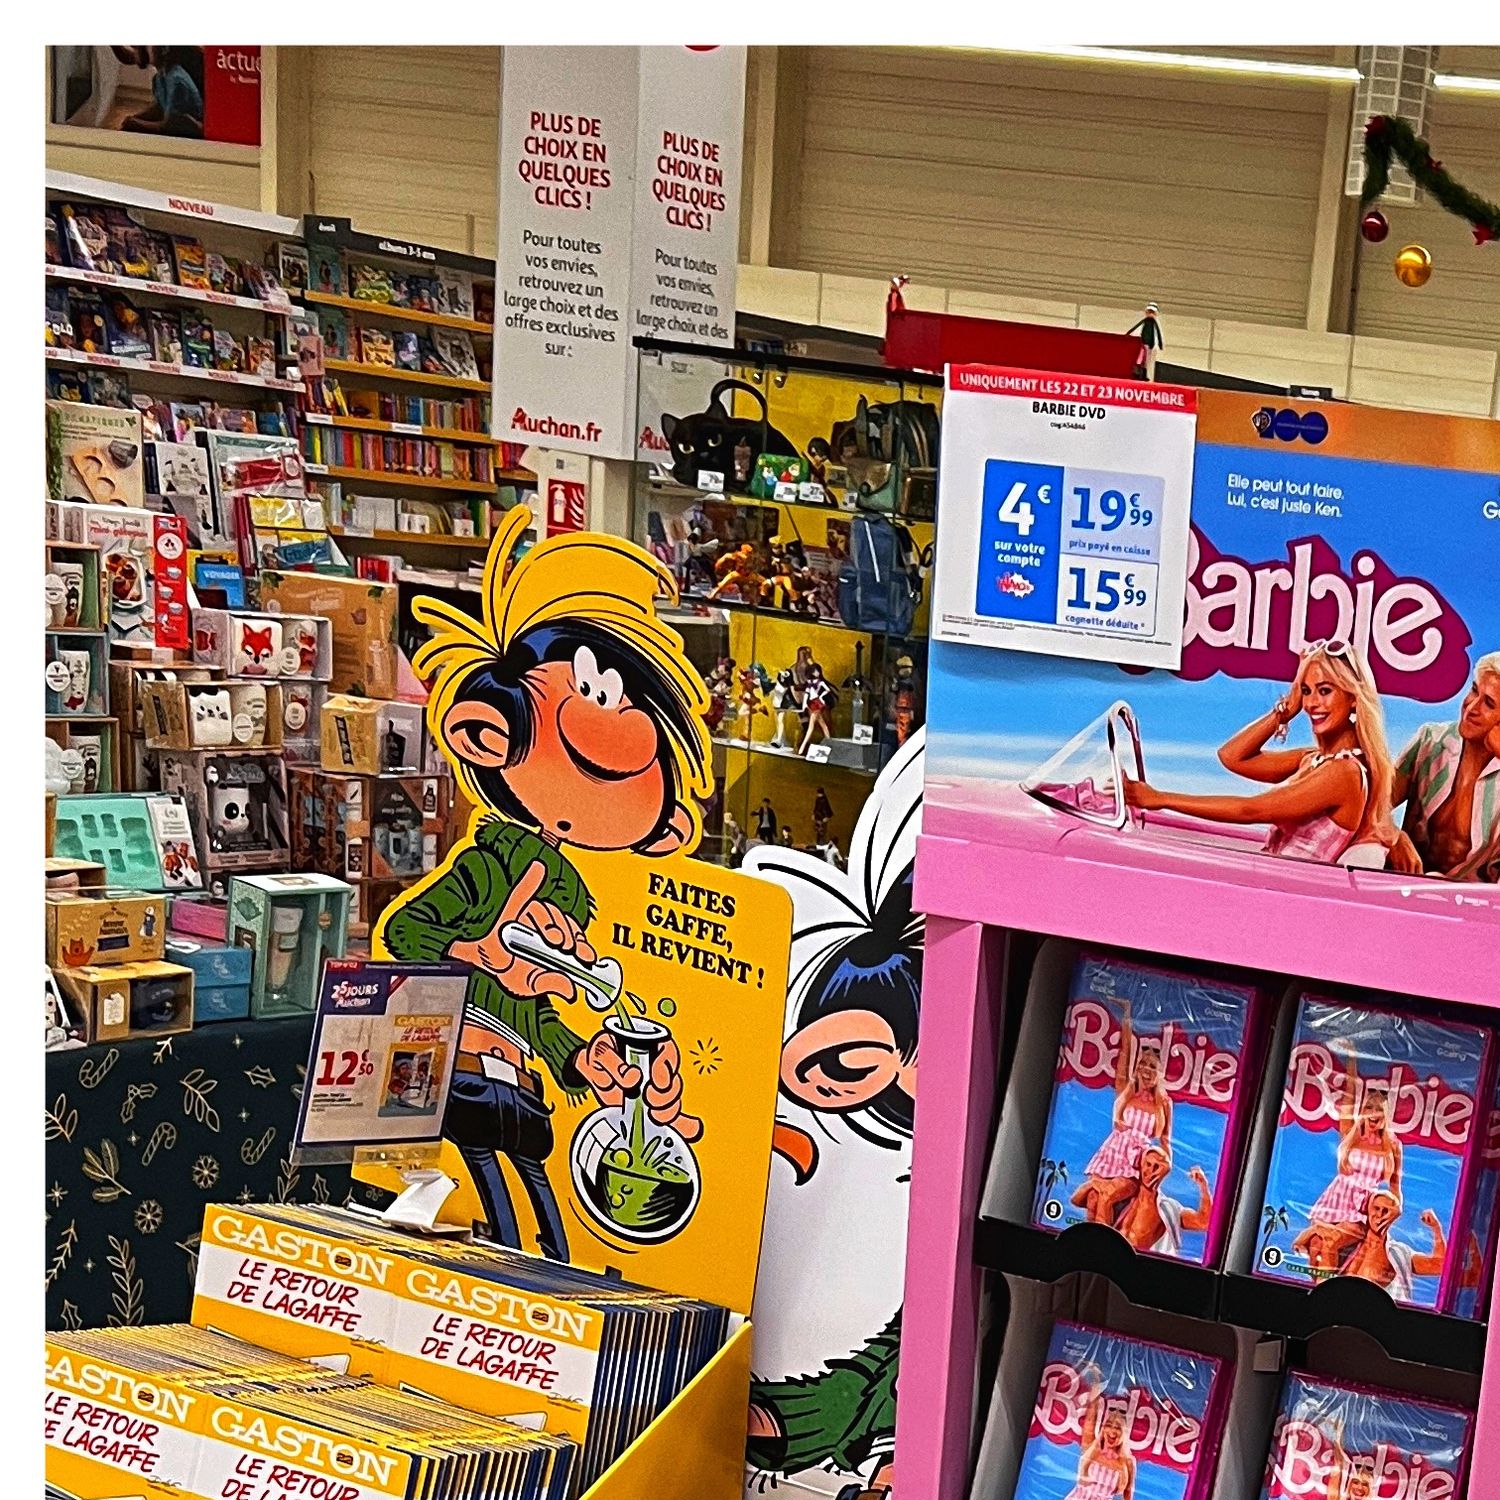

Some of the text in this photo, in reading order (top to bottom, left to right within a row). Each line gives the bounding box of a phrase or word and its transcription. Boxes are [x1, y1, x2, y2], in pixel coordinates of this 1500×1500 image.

[530, 111, 601, 137] PLUS DE
[524, 136, 606, 163] CHOIX EN
[663, 131, 719, 162] PLUS DE
[518, 160, 611, 189] QUELQUES
[657, 155, 723, 187] CHOIX EN
[168, 198, 214, 216] NOUVEAU
[535, 186, 581, 208] CLICS
[653, 178, 726, 212] QUELQUES
[666, 206, 704, 231] CLICS
[523, 229, 601, 254] Pour toutes
[525, 255, 598, 278] vos envies,
[655, 248, 718, 276] Pour toutes
[519, 274, 604, 298] retrouvez un
[656, 273, 676, 288] vos
[504, 291, 619, 322] large choix et des
[650, 293, 718, 317] retrouvez un
[505, 313, 616, 342] offres exclusives
[636, 309, 666, 332] large
[667, 317, 697, 334] choix
[960, 372, 1185, 407] UNIQUEMENT LES 22 ET 23 NOVEMBRE
[1032, 401, 1106, 420] BARBIE DVD
[1228, 473, 1344, 500] Elle peut tout faire.
[1250, 495, 1279, 511] c'est
[1281, 497, 1312, 515] juste
[1315, 502, 1343, 518] Ken.
[994, 540, 1046, 555] sur votre
[997, 555, 1041, 568] compte
[1069, 539, 1151, 556] prix payé caisse
[1065, 615, 1103, 628] cagnotte
[1106, 617, 1139, 631] déduite
[648, 872, 736, 918] FAITES
[646, 904, 733, 953] GAFFE,
[612, 923, 752, 984] IL REVIENT
[1059, 1001, 1238, 1101] Barbie
[1282, 1044, 1474, 1145] Barbie
[212, 1214, 394, 1288] GASTON
[239, 1259, 359, 1308] LE RETOUR
[227, 1281, 362, 1332] DE LAGAFFE
[406, 1269, 593, 1343] GASTON
[433, 1313, 557, 1366] LE RETOUR
[422, 1337, 559, 1390] DE LAGAFFE
[72, 1403, 160, 1446] RETOUR
[1033, 1363, 1200, 1463] Barbie
[63, 1427, 160, 1474] LAGAFFE
[211, 1406, 398, 1487] GASTON
[235, 1454, 264, 1478] LE
